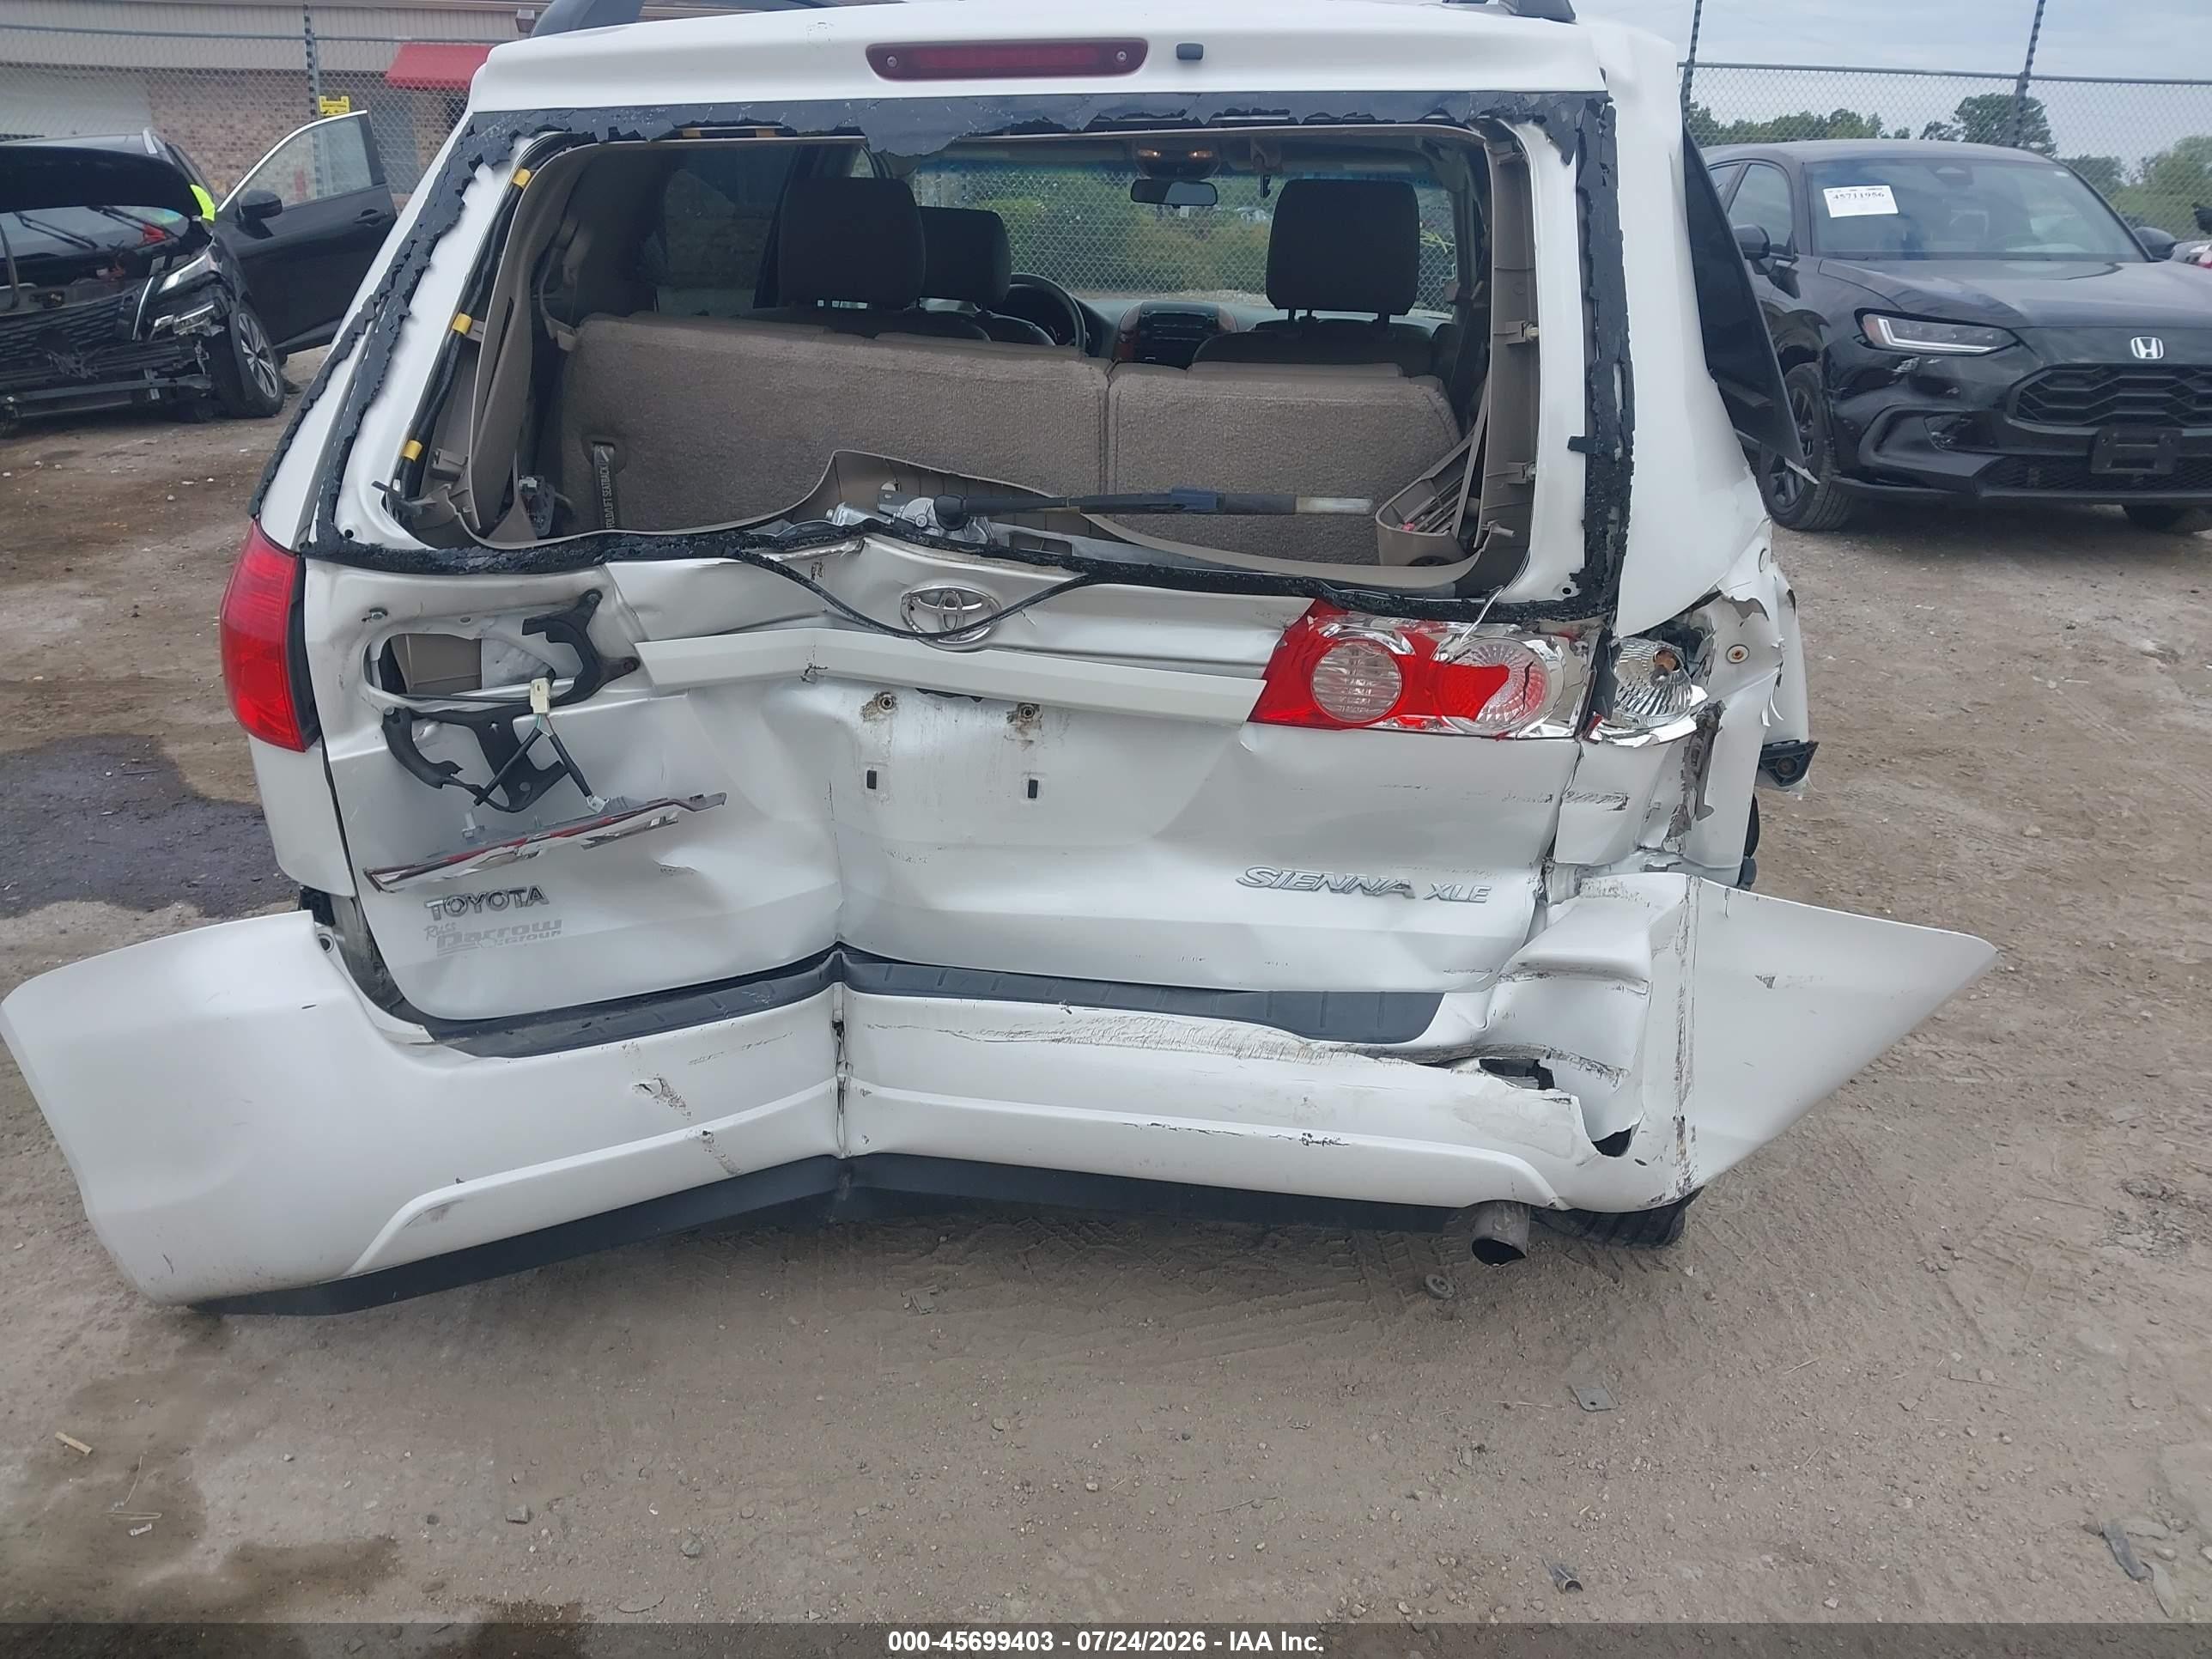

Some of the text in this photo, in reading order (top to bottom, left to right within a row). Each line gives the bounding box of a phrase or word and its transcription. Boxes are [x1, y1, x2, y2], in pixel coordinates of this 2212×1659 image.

[600, 465, 611, 496] SEATBACK
[423, 884, 550, 921] TOYOTA
[1235, 865, 1492, 903] SIENNA XLE
